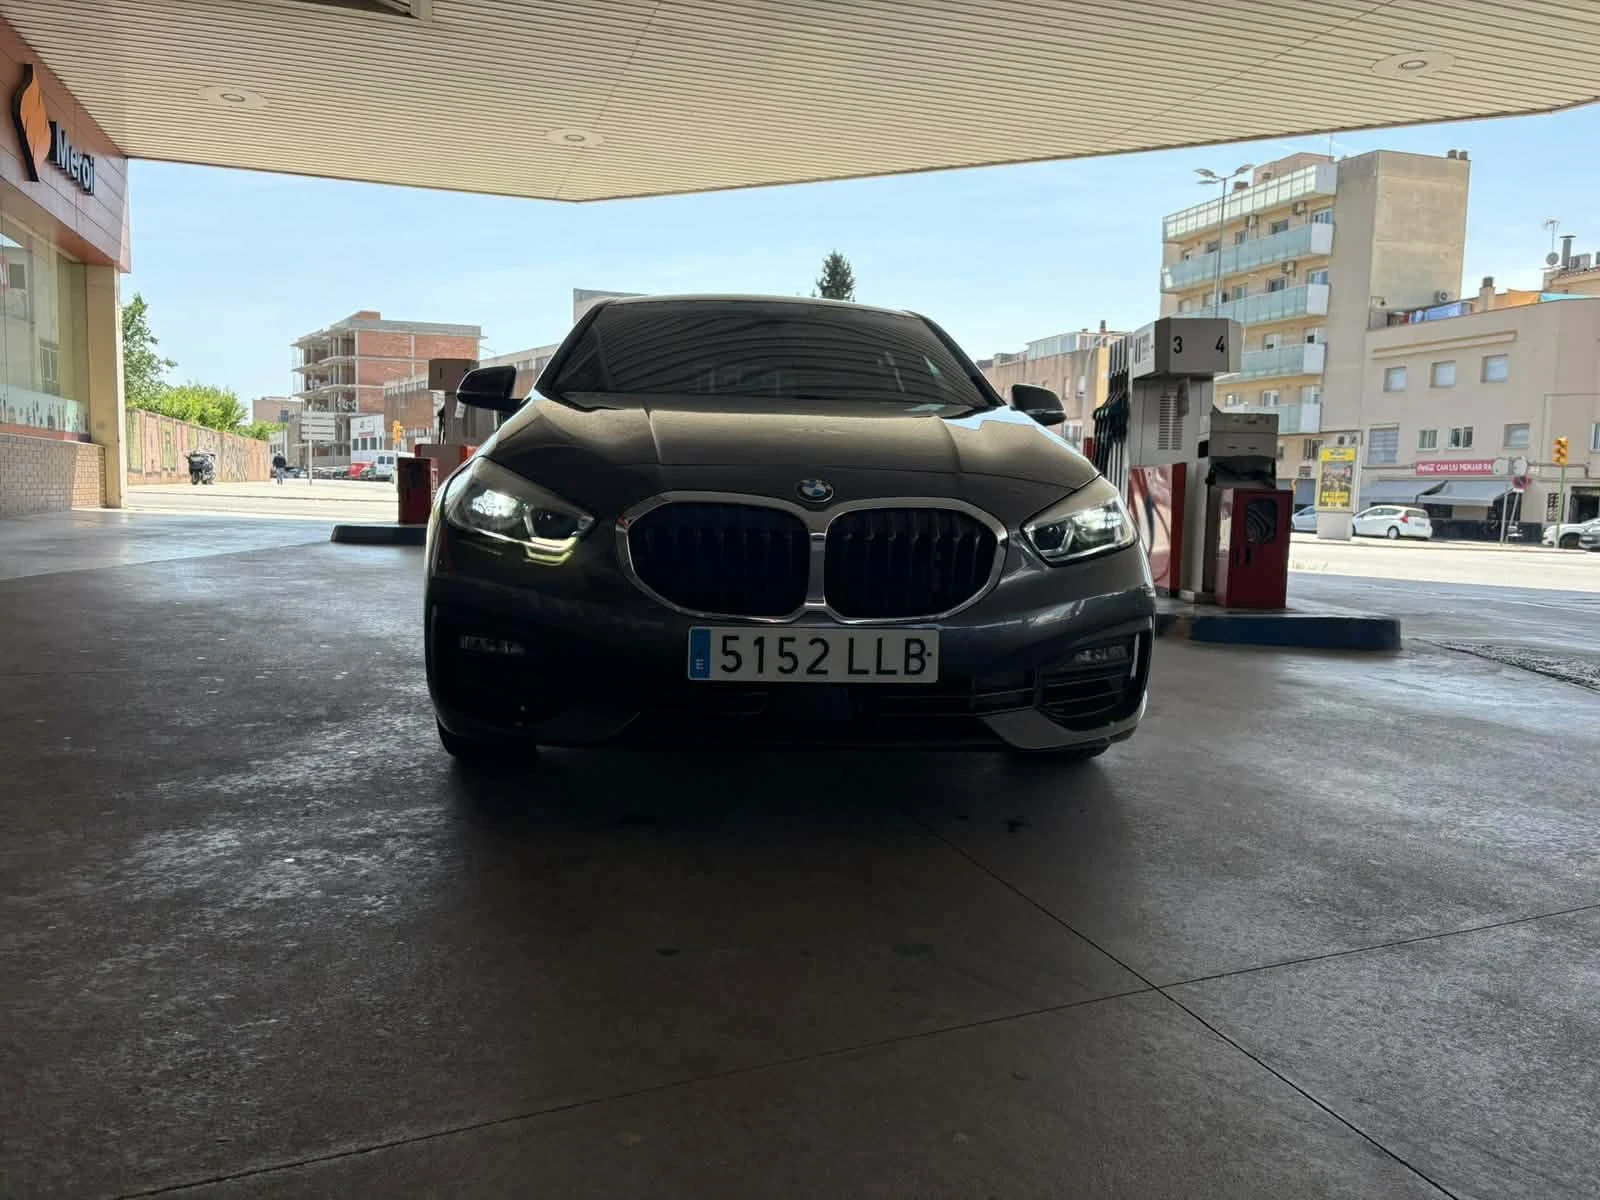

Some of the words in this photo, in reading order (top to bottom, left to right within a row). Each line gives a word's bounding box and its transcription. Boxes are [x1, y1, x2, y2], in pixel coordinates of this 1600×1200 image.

[1173, 336, 1183, 354] 3
[1215, 335, 1225, 353] 4
[720, 635, 831, 675] 5152
[847, 636, 927, 676] LLB
